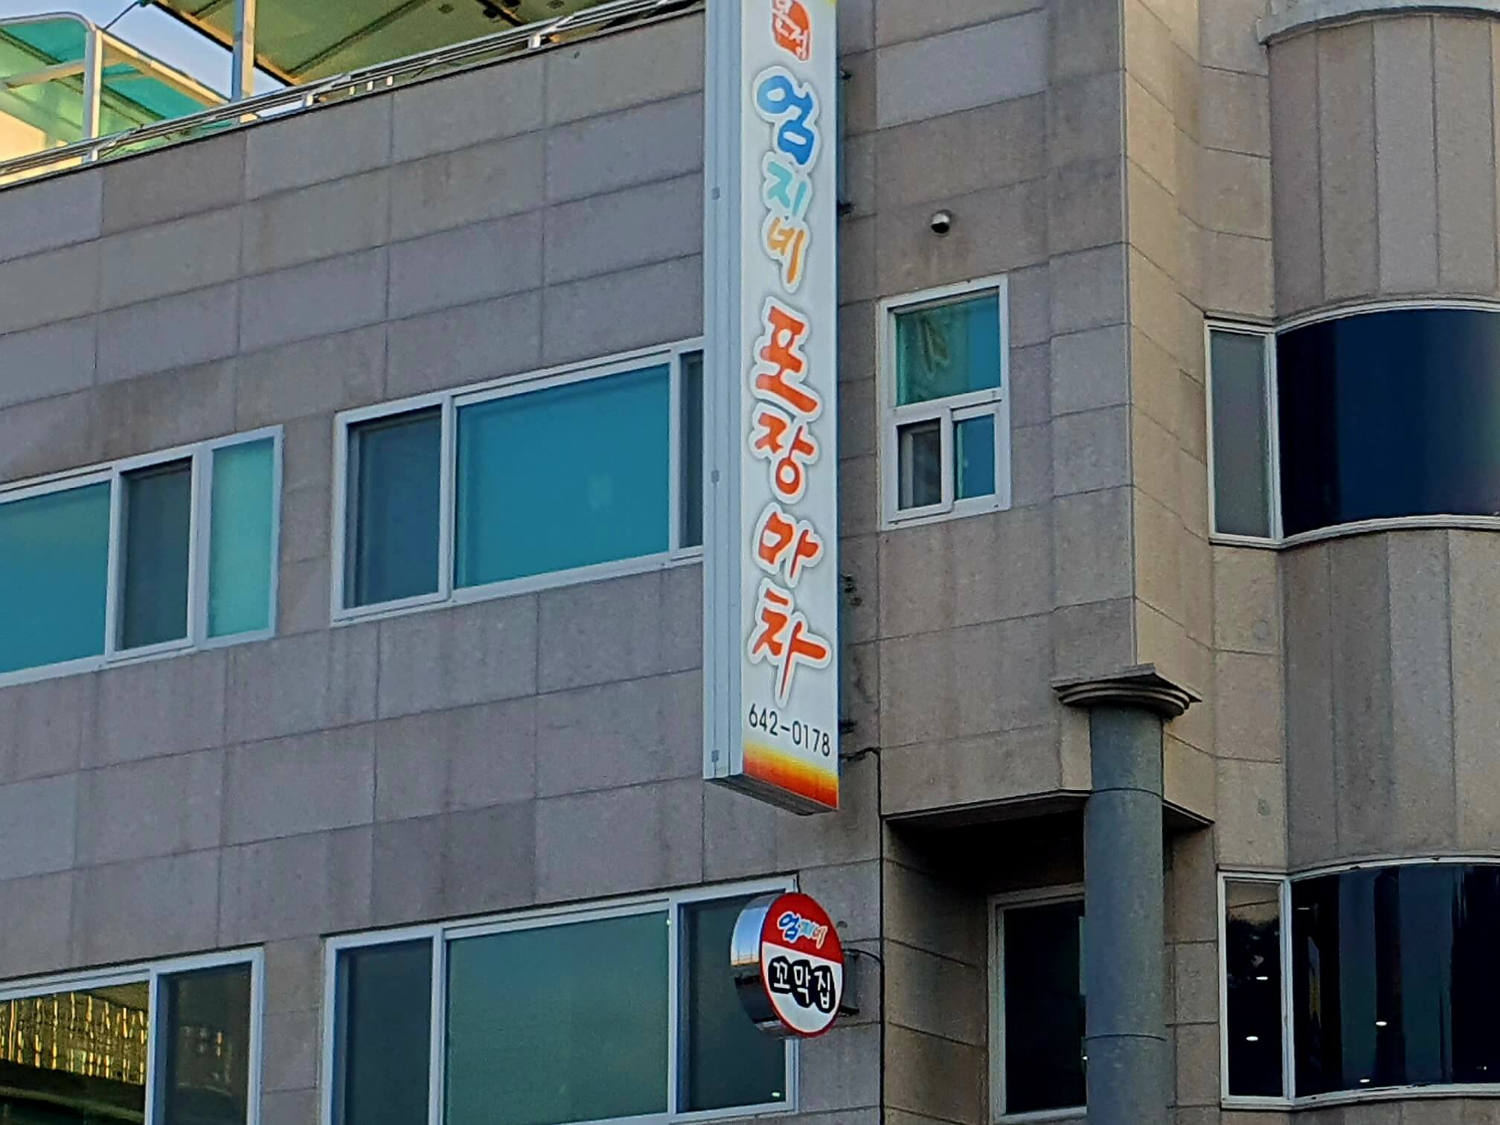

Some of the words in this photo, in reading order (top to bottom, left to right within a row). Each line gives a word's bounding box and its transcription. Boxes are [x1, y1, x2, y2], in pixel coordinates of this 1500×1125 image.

[757, 75, 815, 284] 엄지네
[753, 305, 829, 698] 포장마차
[747, 702, 831, 759] 642-0178
[778, 911, 829, 950] 엄지네
[773, 960, 831, 1010] 꼬막집
